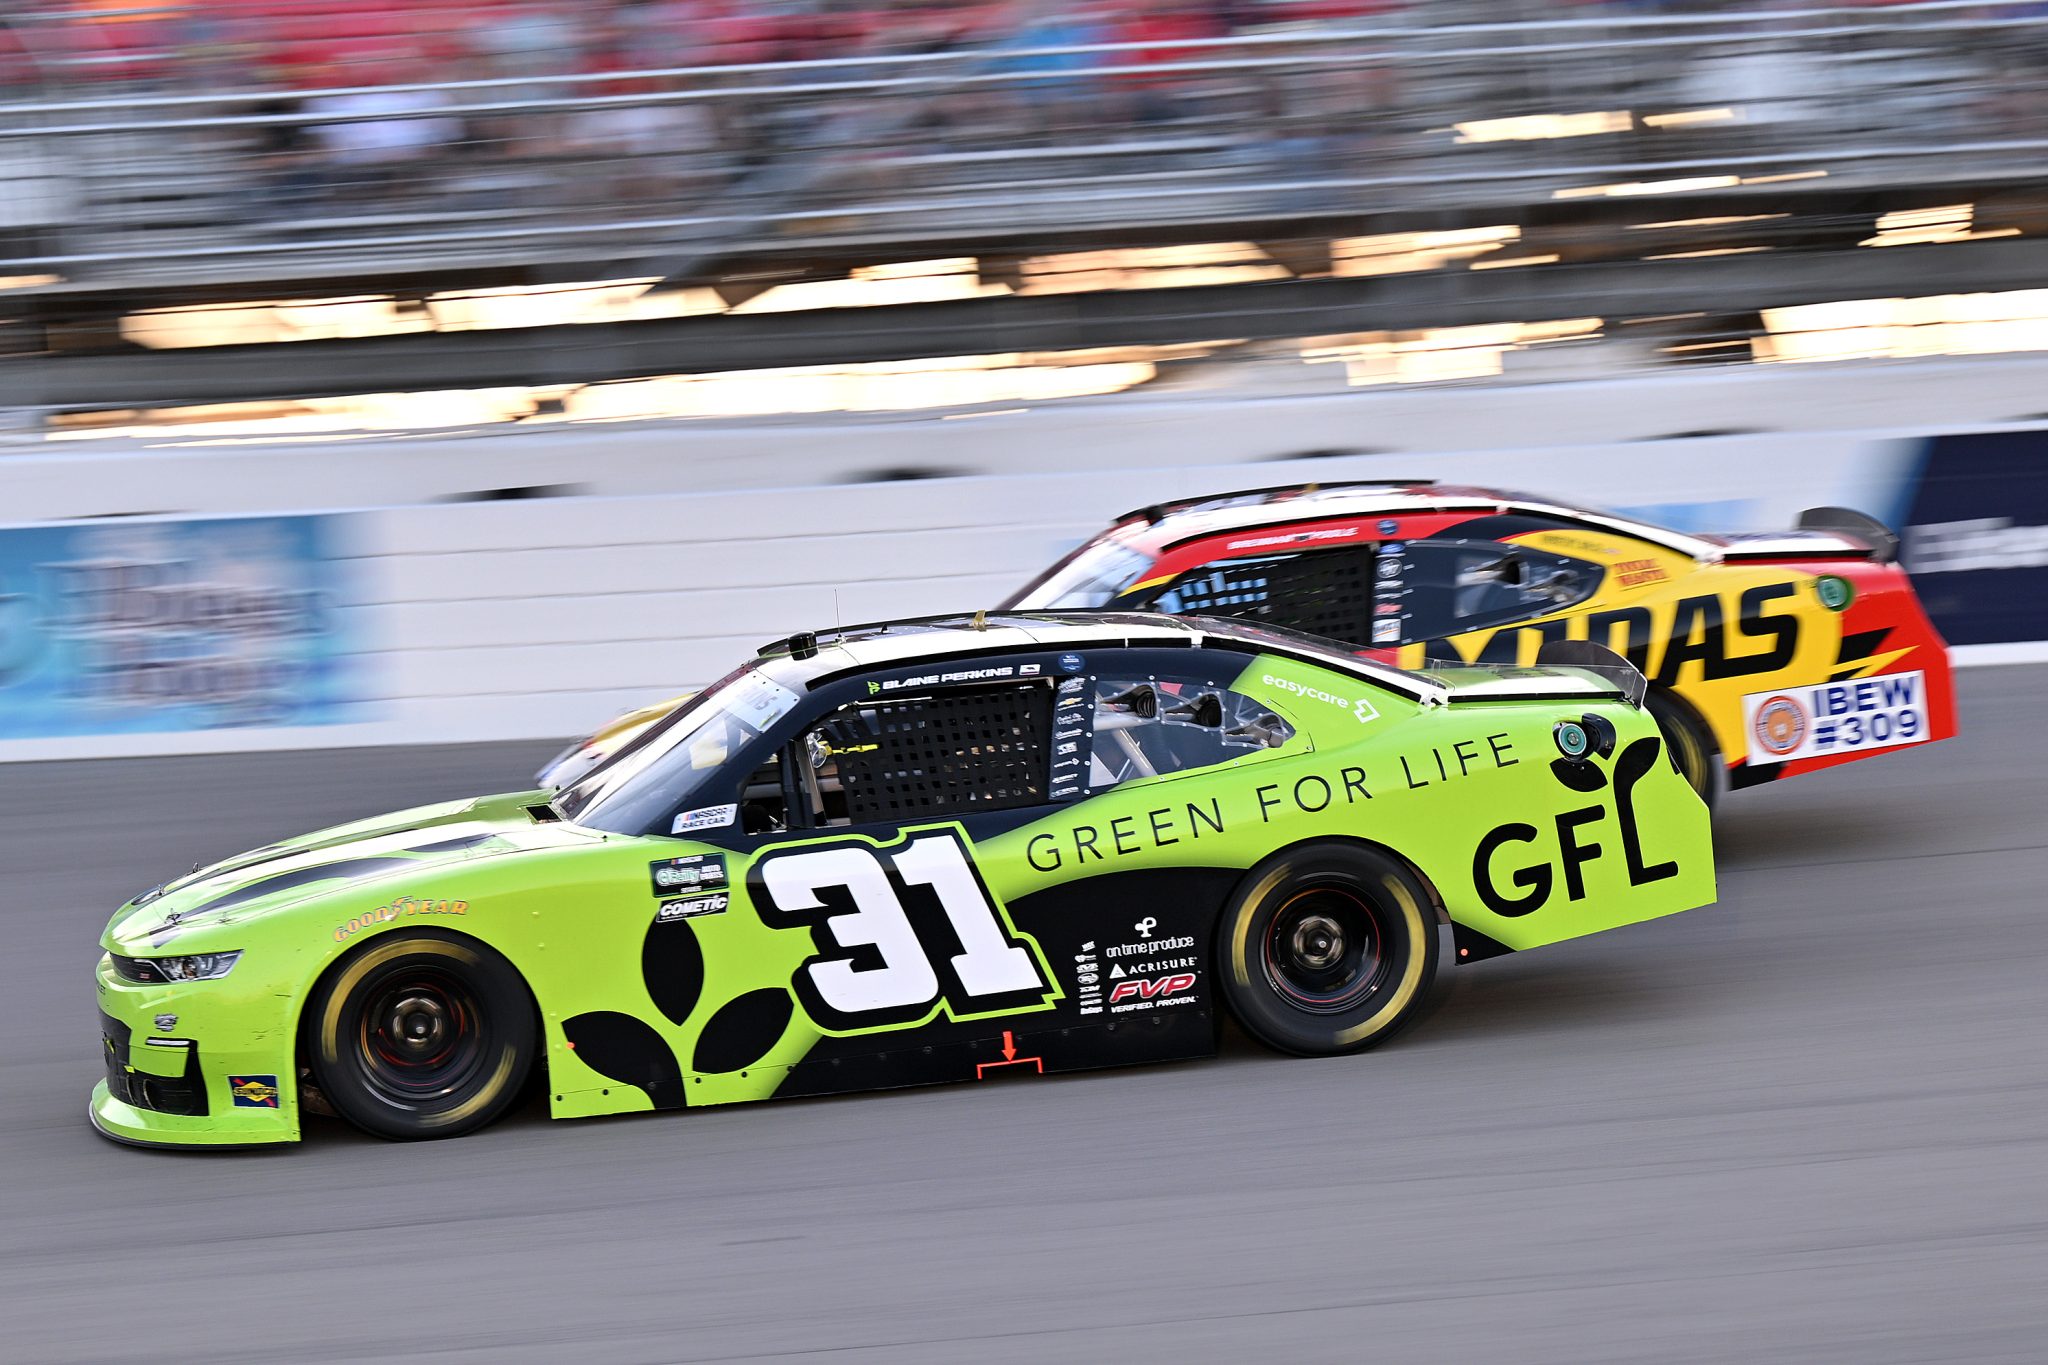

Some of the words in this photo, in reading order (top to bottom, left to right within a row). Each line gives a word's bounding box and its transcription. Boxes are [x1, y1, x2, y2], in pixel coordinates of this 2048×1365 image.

[1424, 581, 1797, 688] MDAS
[882, 675, 940, 690] BLAINE
[941, 667, 1014, 682] PERKINS
[1262, 674, 1350, 708] easycare
[1812, 676, 1916, 718] IBEW
[693, 807, 728, 821] NASCAR
[1026, 798, 1225, 873] GREEN
[1256, 767, 1374, 823] FOR
[1400, 733, 1520, 790] LIFE
[681, 819, 705, 829] RACE
[707, 816, 726, 825] CAR
[1472, 736, 1679, 918] GFL
[333, 896, 469, 943] GOODYEAR
[761, 834, 1044, 1013] 31
[1106, 947, 1122, 958] on
[1121, 943, 1148, 955] time
[1149, 936, 1195, 954] produce
[1129, 957, 1196, 974] ACRISURE
[1109, 973, 1196, 1003] FVP
